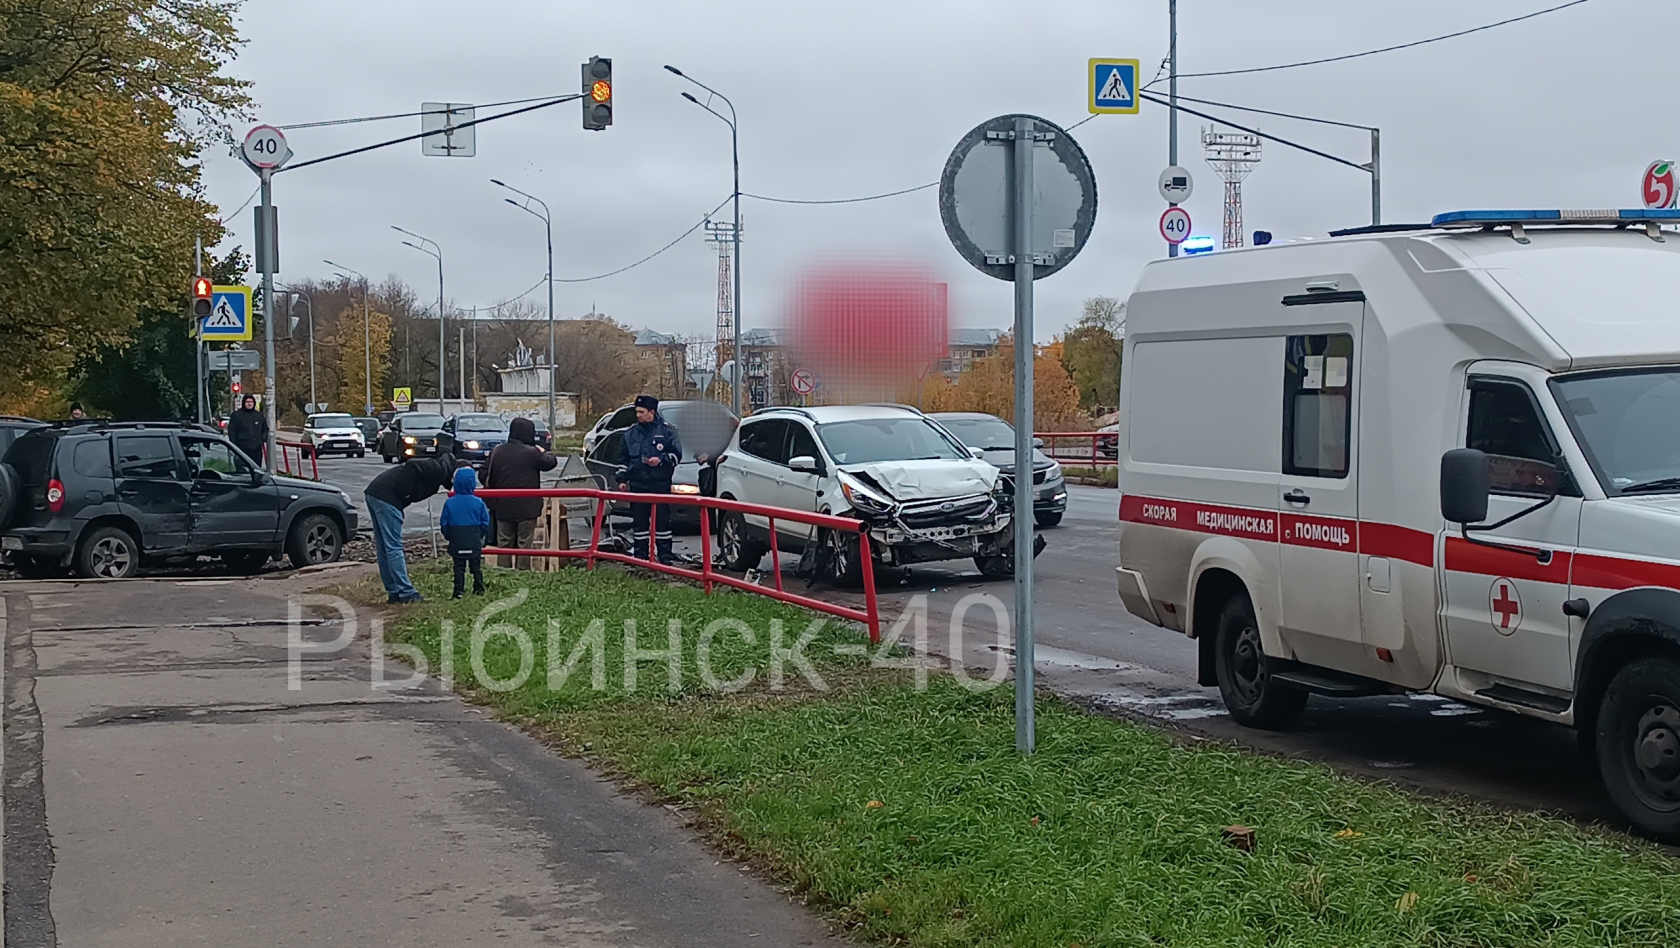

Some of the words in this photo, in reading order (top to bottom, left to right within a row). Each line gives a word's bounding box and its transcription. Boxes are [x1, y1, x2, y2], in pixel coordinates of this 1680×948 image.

[253, 138, 277, 155] 40
[1648, 176, 1668, 208] 5
[1166, 218, 1185, 232] 40
[1143, 503, 1177, 522] СКОРАЯ
[1196, 510, 1274, 535] МЕДИЦИНСКАЯ
[1295, 522, 1350, 547] ПОМОЩЬ
